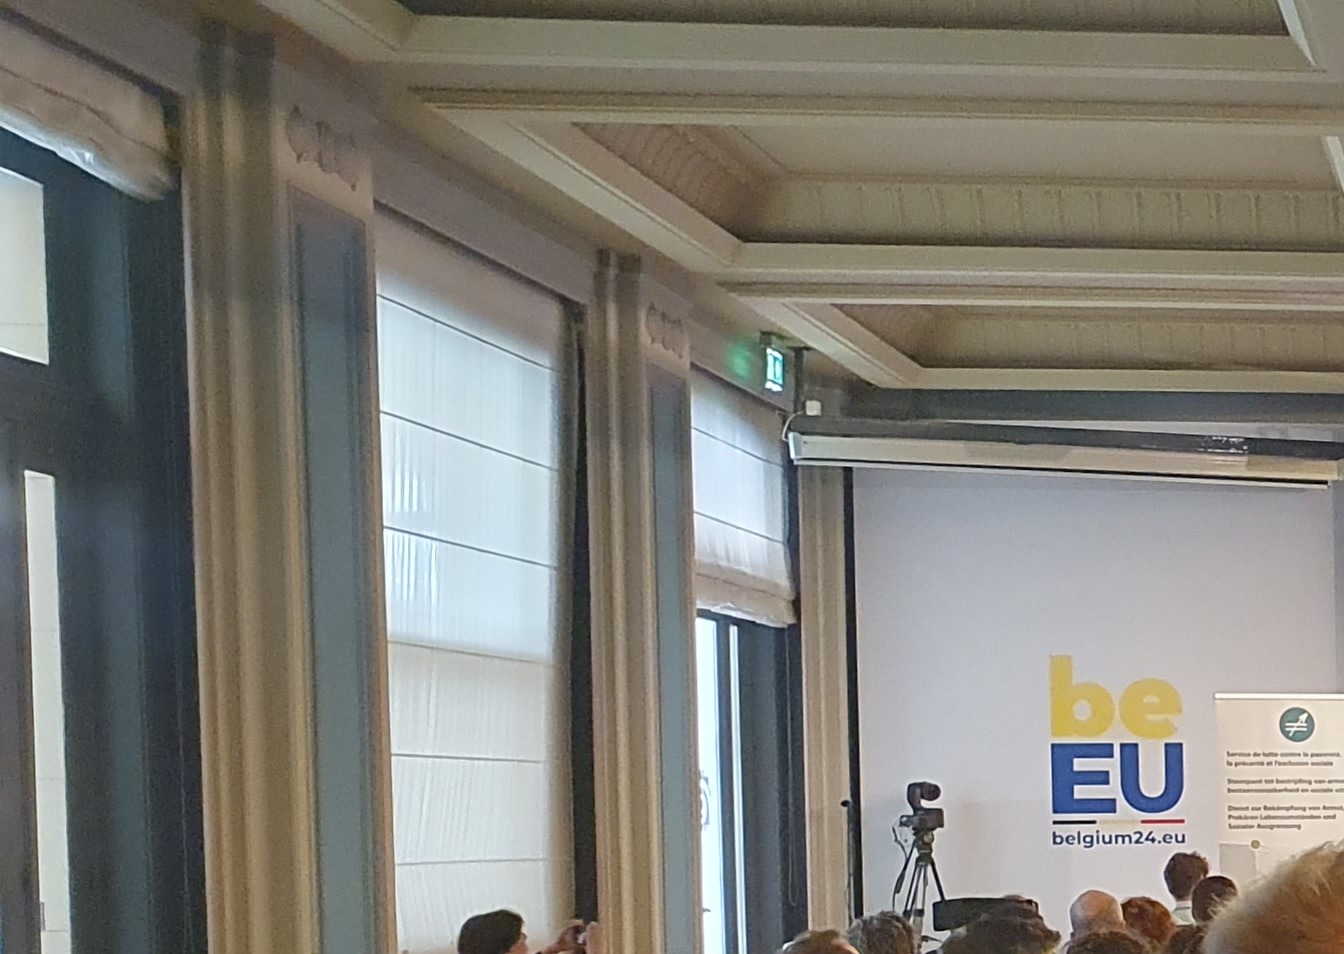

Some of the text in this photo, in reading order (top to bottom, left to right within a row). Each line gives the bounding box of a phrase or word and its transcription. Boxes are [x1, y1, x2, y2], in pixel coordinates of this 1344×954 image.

[1049, 654, 1183, 740] be
[1050, 742, 1184, 814] EU
[1052, 830, 1186, 848] belgium24.eu
